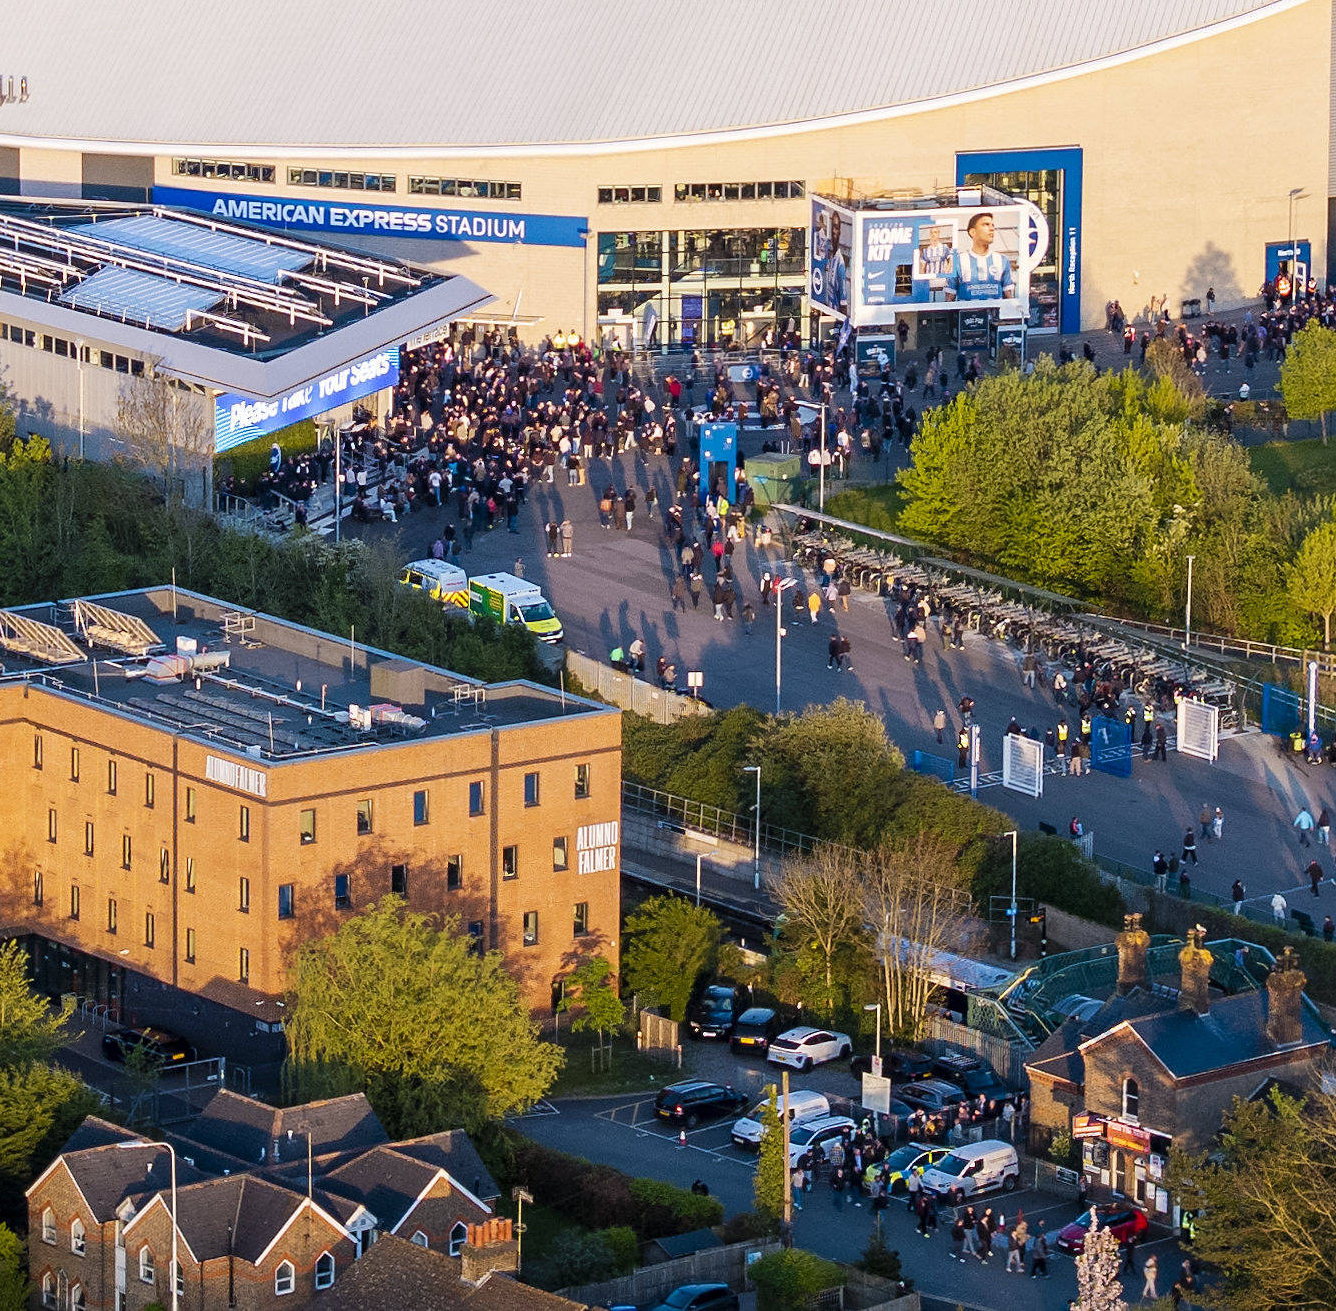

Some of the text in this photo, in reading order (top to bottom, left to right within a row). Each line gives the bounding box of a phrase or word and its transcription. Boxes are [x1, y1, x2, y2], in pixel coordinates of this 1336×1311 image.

[212, 198, 526, 239] AMERICAN EXPRESS STADIUM
[868, 227, 913, 245] HOME
[868, 245, 893, 262] KIT
[1068, 273, 1076, 295] North
[230, 400, 279, 431] Please
[350, 353, 390, 386] Seats
[576, 821, 618, 851] ALUMNO
[578, 846, 616, 875] FALMER
